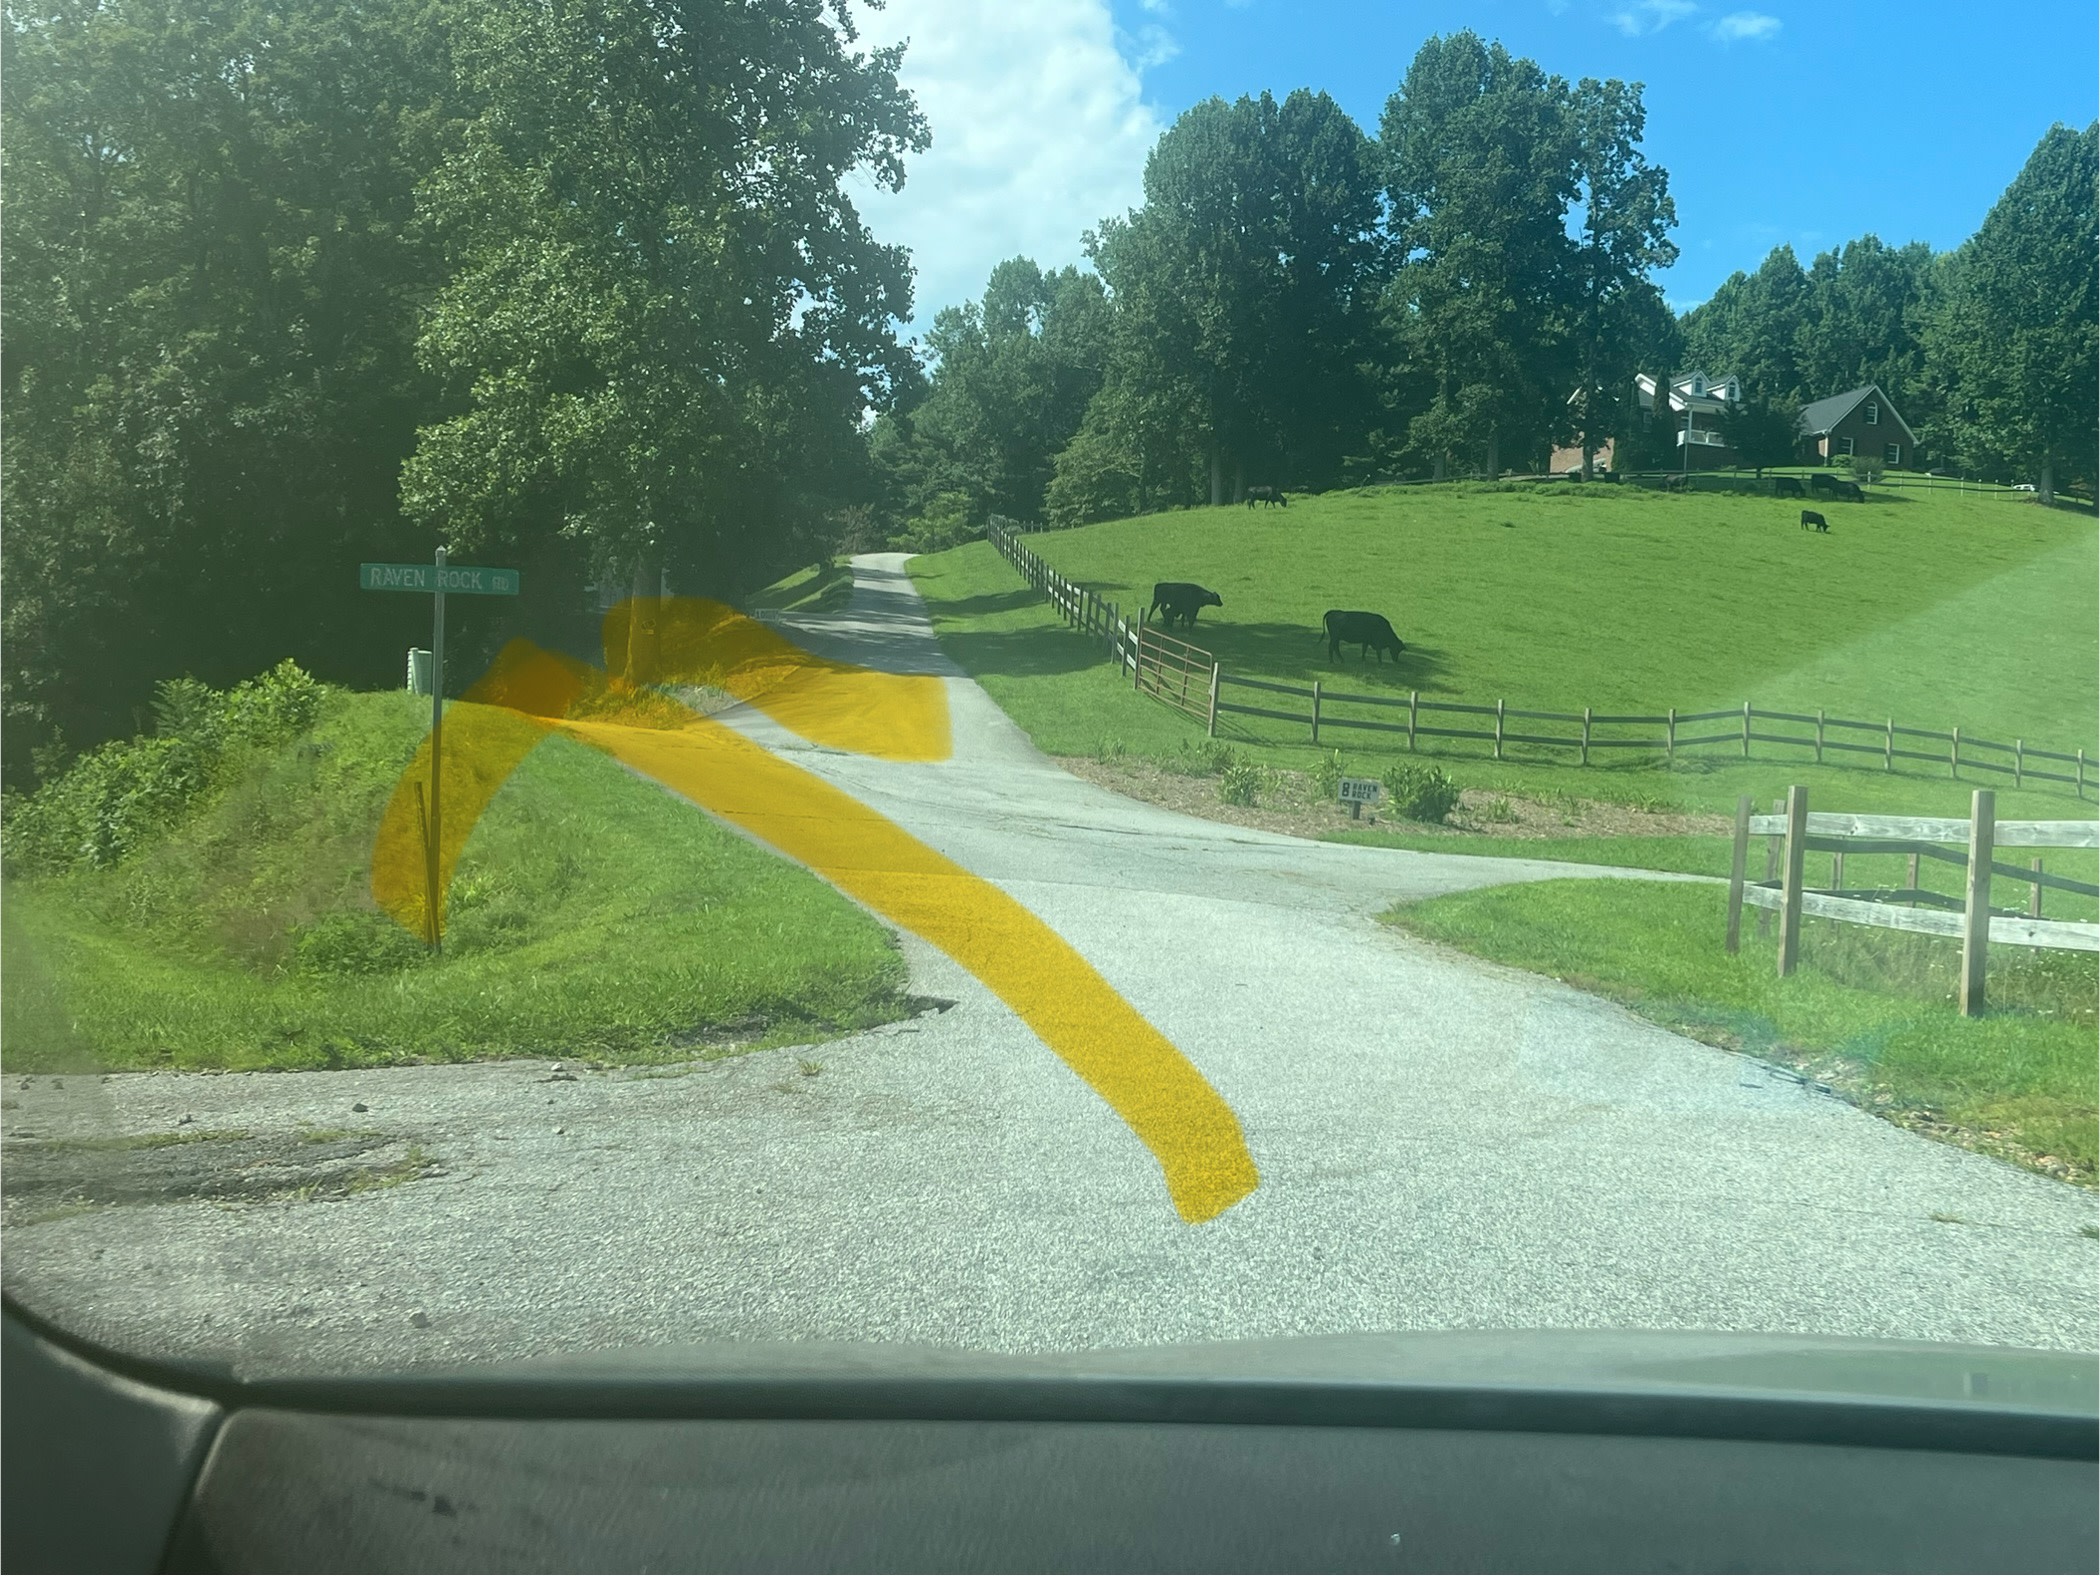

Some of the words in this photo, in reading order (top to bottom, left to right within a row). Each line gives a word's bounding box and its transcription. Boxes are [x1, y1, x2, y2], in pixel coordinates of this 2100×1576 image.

[370, 567, 425, 587] RAVEN
[437, 569, 482, 590] ROCK
[1342, 782, 1350, 797] 8
[1353, 783, 1378, 793] RAVEN
[1352, 790, 1371, 800] ROCK
